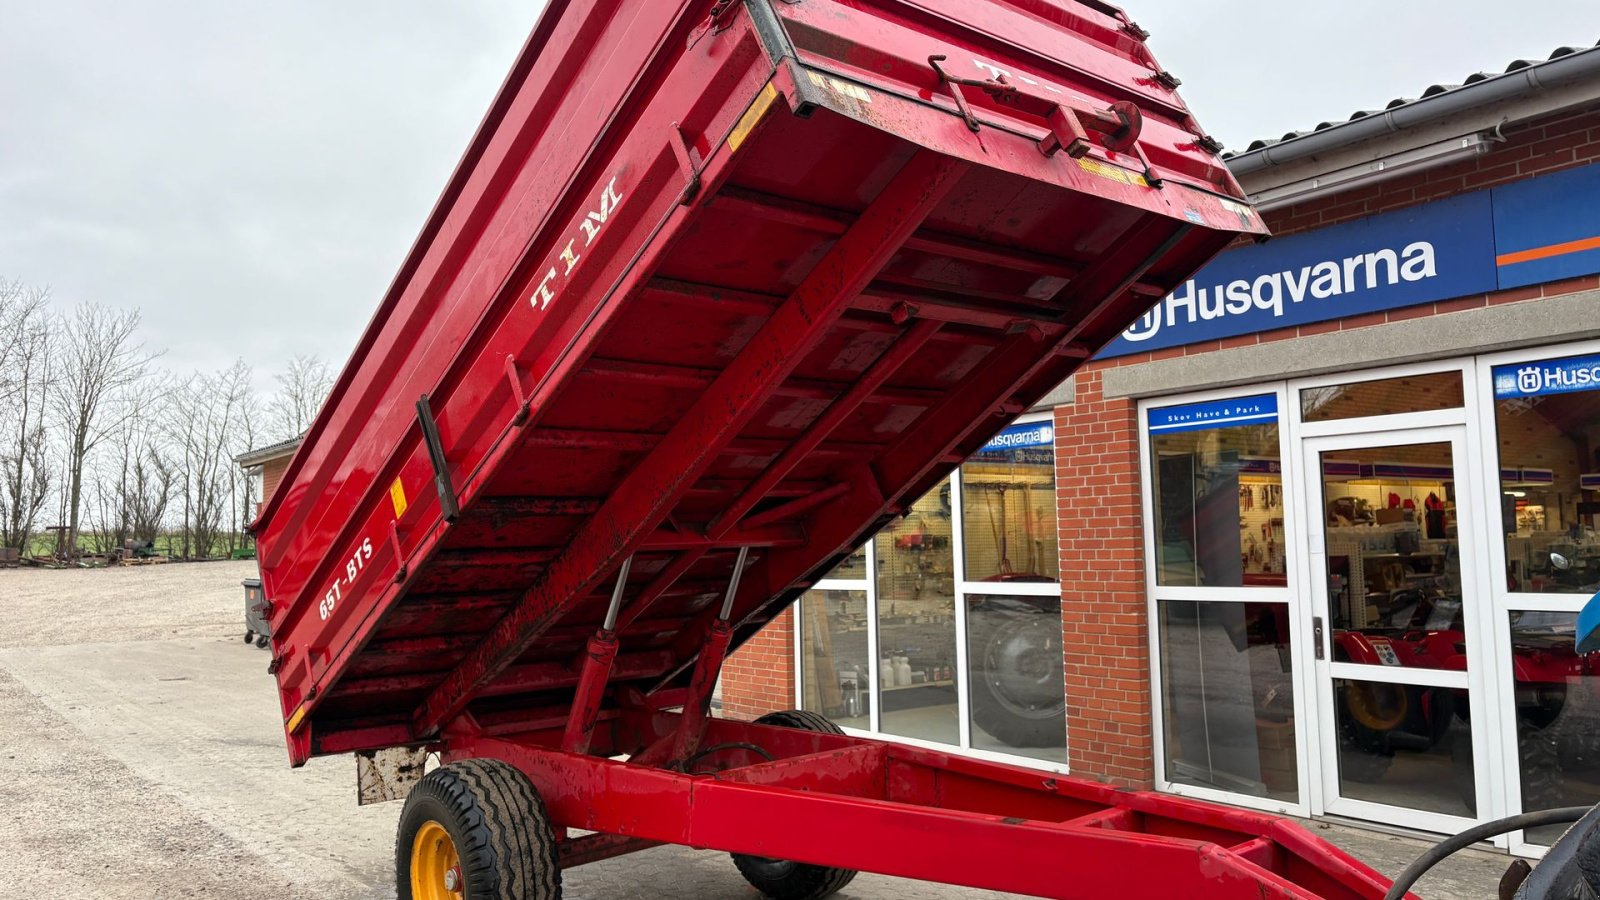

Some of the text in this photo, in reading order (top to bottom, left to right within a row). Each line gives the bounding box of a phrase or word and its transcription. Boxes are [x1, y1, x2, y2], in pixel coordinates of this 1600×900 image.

[530, 175, 623, 311] TIM
[1165, 241, 1437, 327] Husqvarna
[1168, 405, 1260, 422] Skov Have & Park
